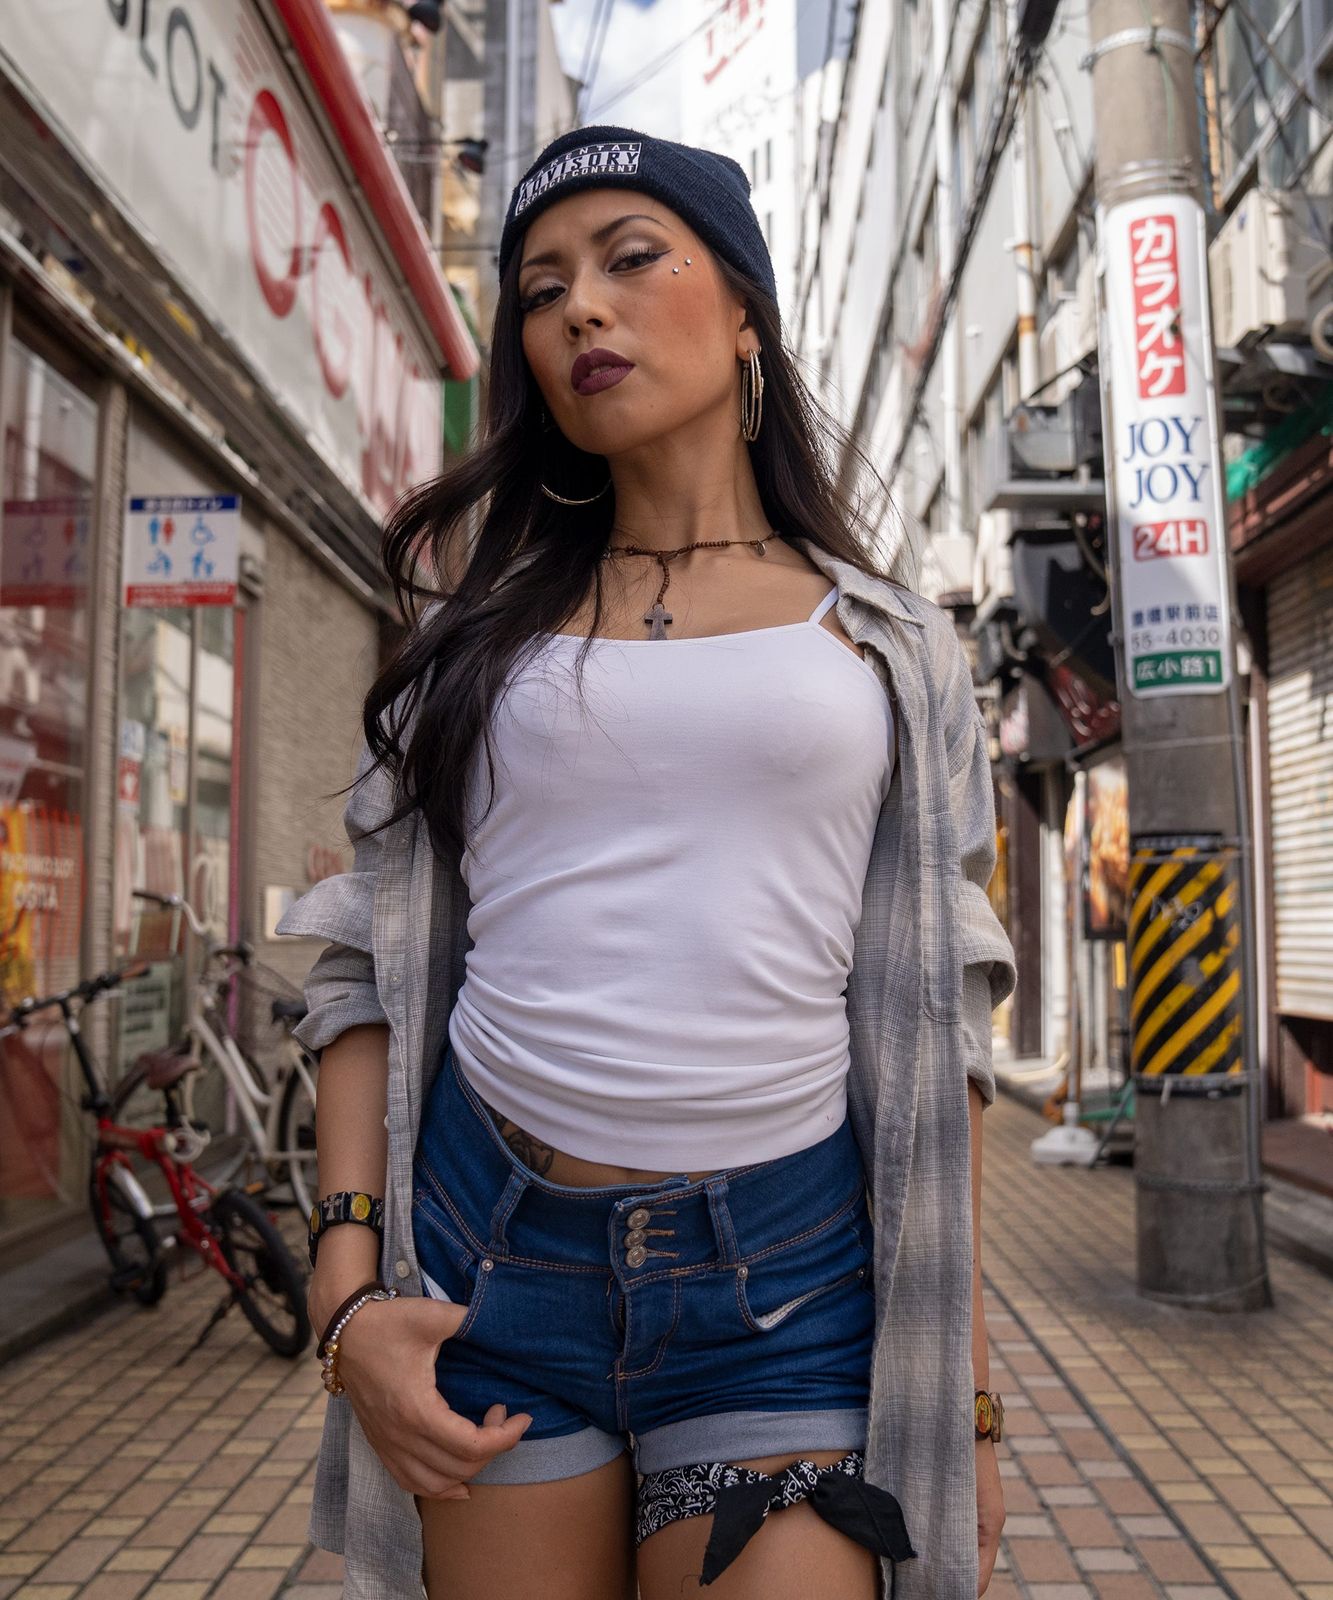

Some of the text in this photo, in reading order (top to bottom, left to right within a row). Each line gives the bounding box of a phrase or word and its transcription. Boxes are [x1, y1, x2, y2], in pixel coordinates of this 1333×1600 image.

[519, 151, 638, 200] ADVISORY
[571, 165, 634, 177] CONTENT
[1131, 217, 1184, 397] カラオケ
[1123, 415, 1203, 463] JOY
[1129, 463, 1211, 509] JOY
[1135, 520, 1207, 559] 24H
